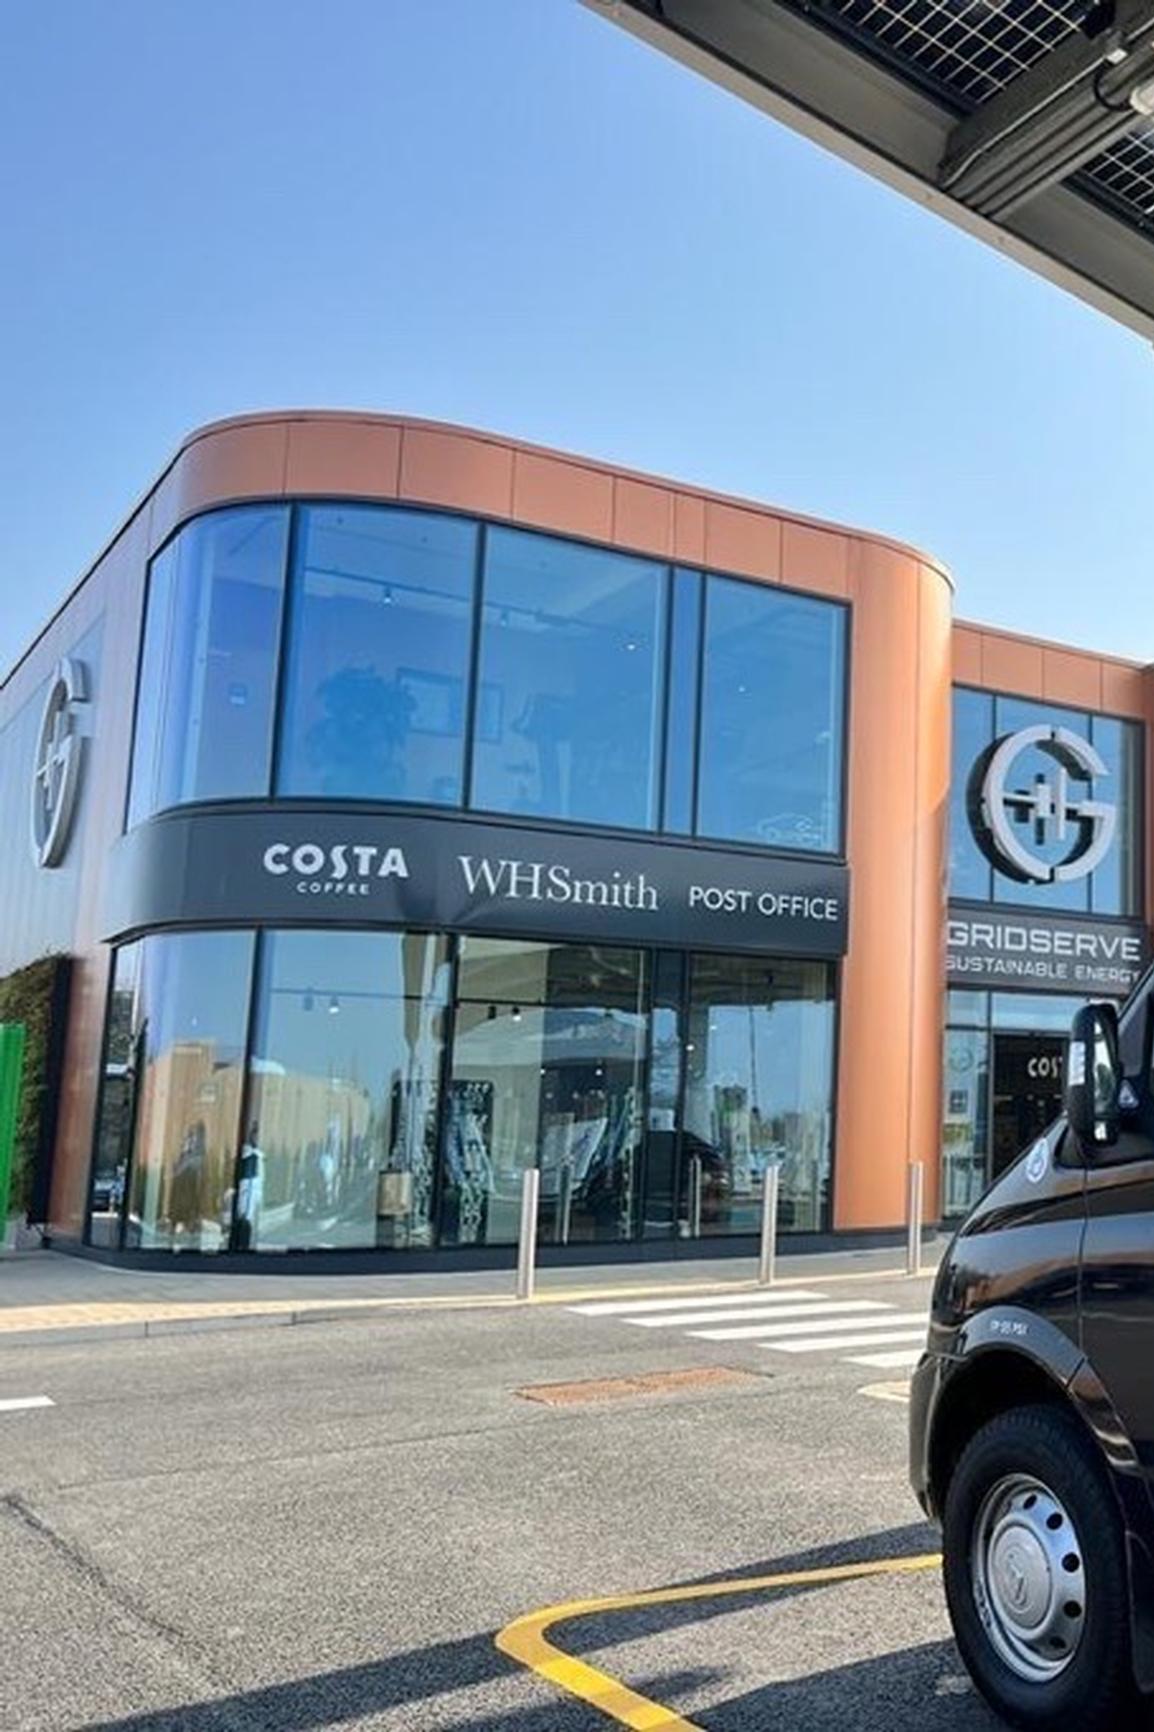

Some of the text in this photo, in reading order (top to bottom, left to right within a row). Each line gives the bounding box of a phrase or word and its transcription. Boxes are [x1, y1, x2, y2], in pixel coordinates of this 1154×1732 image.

[263, 843, 409, 879] COSTA
[296, 881, 370, 895] COFFEE
[458, 855, 658, 911] WHSmith
[689, 886, 839, 921] POST OFFICE
[947, 921, 1142, 962] GRIDSERVE
[946, 954, 1142, 984] SUSTAINABLE ENERGY
[1027, 1056, 1063, 1078] COS
